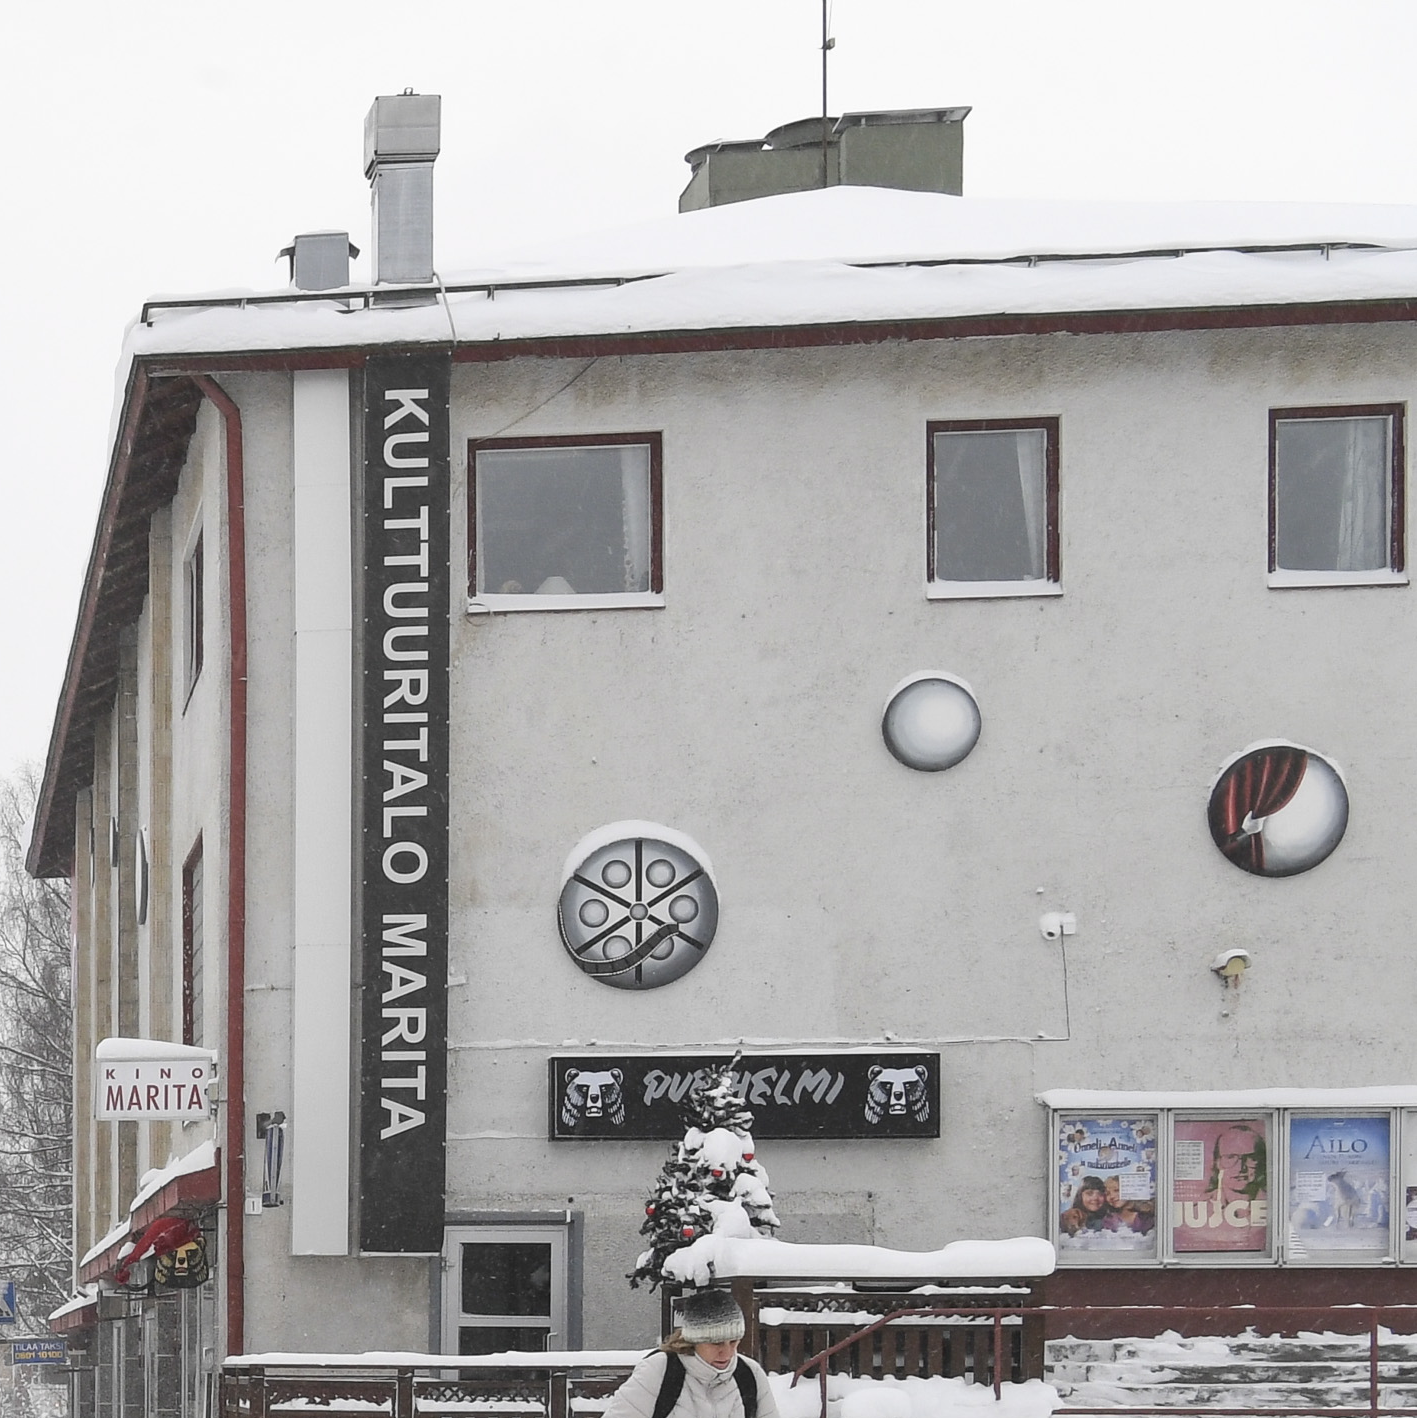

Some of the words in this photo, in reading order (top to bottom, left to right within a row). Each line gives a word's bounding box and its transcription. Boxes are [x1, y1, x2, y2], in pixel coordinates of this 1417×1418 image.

[381, 387, 431, 886] KULTTUURITALO
[105, 1067, 204, 1080] KINO
[379, 912, 429, 1142] MARITA
[105, 1083, 204, 1112] MARITA
